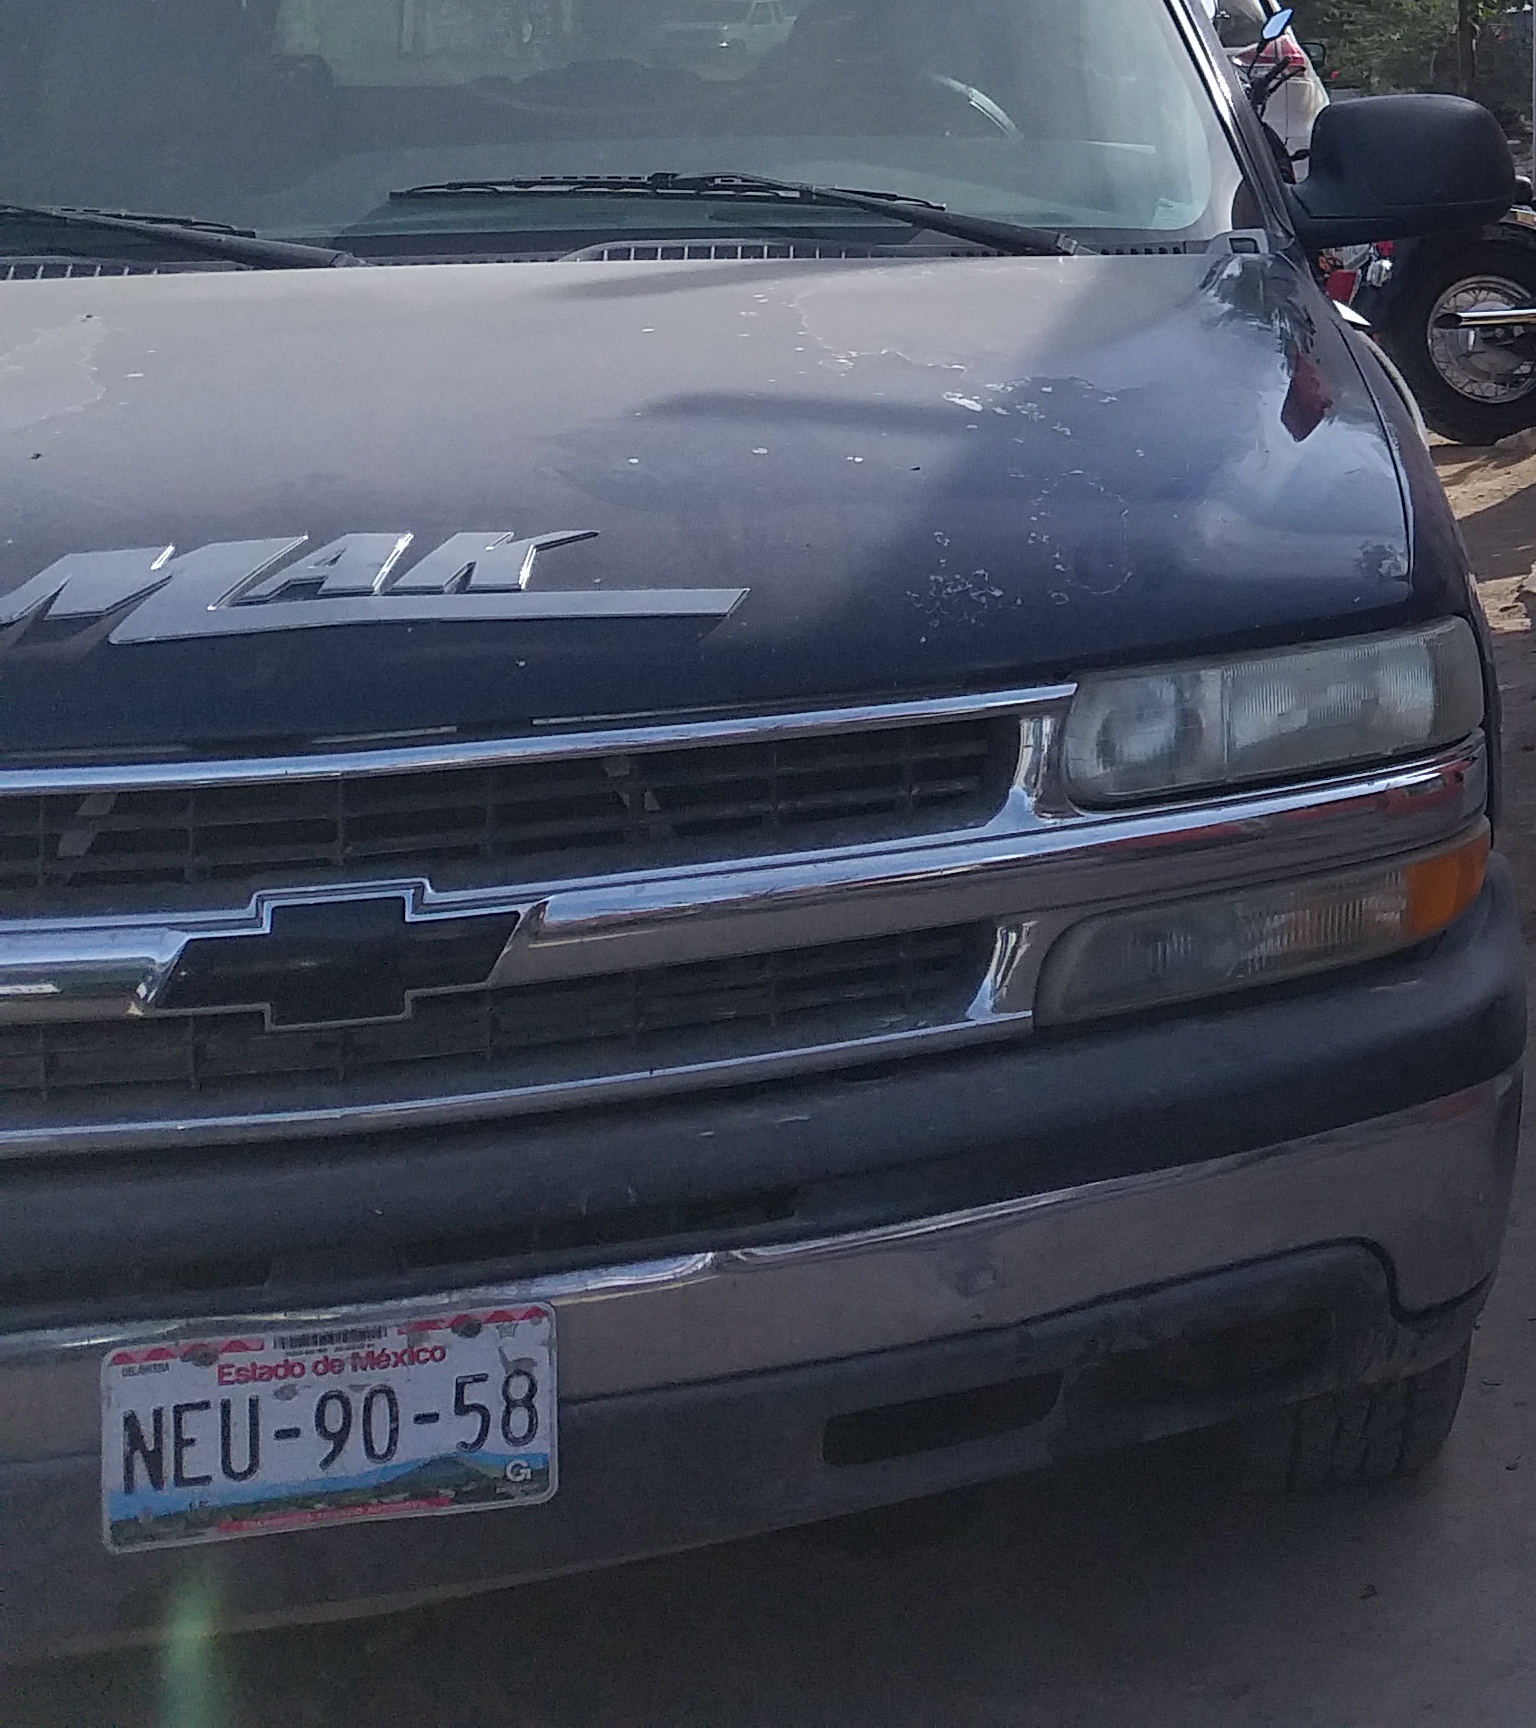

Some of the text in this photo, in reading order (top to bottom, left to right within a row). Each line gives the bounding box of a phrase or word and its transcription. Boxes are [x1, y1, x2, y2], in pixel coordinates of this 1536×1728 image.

[217, 1356, 306, 1387] Estado
[311, 1353, 345, 1378] de
[350, 1343, 447, 1374] México
[121, 1369, 540, 1495] NEU-90-58
